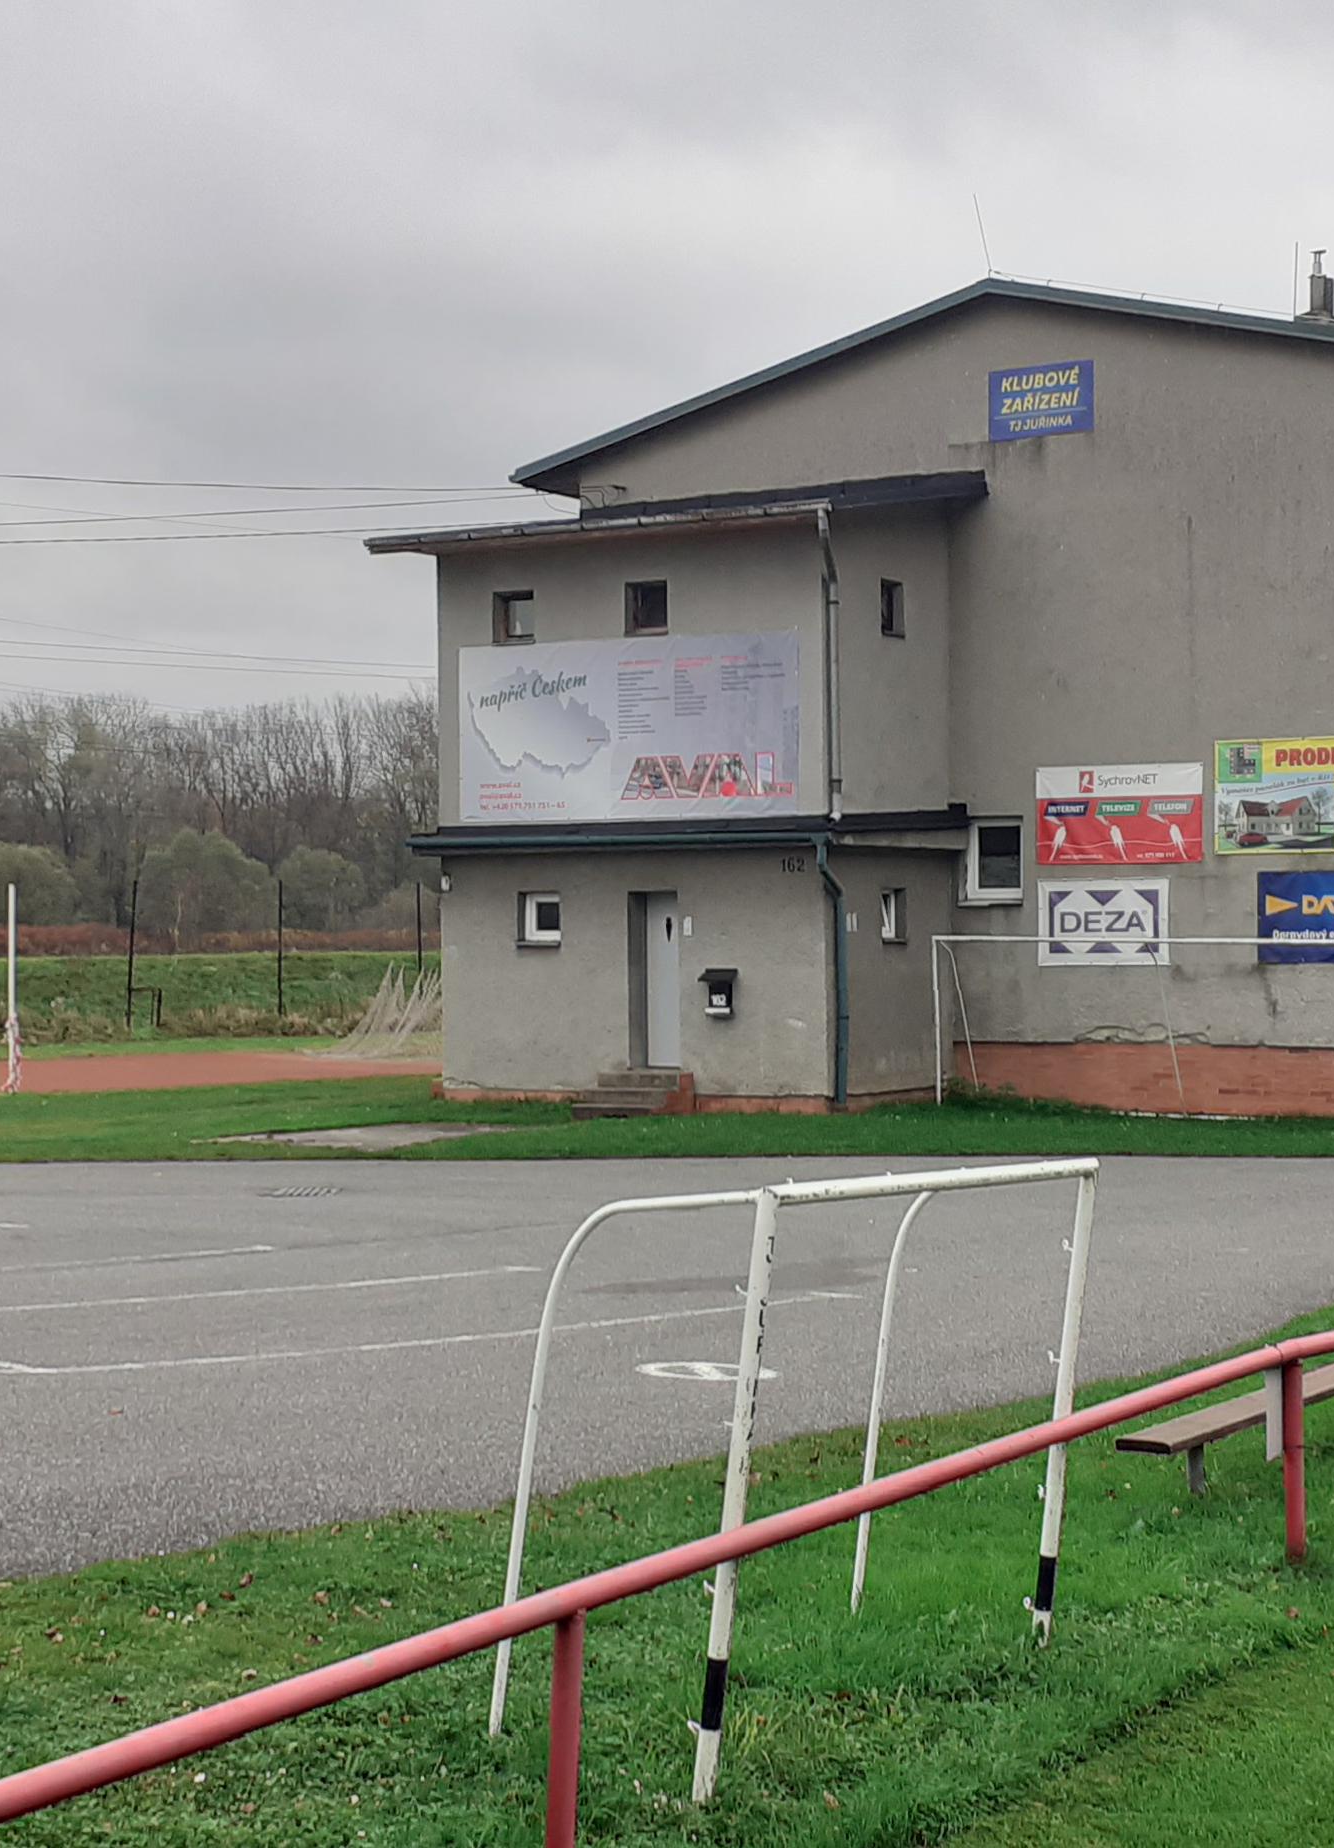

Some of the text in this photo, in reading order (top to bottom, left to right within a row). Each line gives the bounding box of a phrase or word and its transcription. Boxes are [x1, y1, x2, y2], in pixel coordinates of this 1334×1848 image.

[1001, 365, 1080, 393] KLUBOVÉ
[1001, 387, 1080, 415] ZAŘÍZENÍ
[1009, 414, 1073, 432] TJ JUŘINKA
[479, 670, 587, 713] napříč Českem
[621, 751, 794, 800] AVAL
[1097, 773, 1158, 791] SychrovNET
[1047, 804, 1085, 814] INTERNET
[1101, 803, 1135, 813] TELEVIZE
[781, 858, 806, 873] 162
[1060, 910, 1147, 933] DEZA
